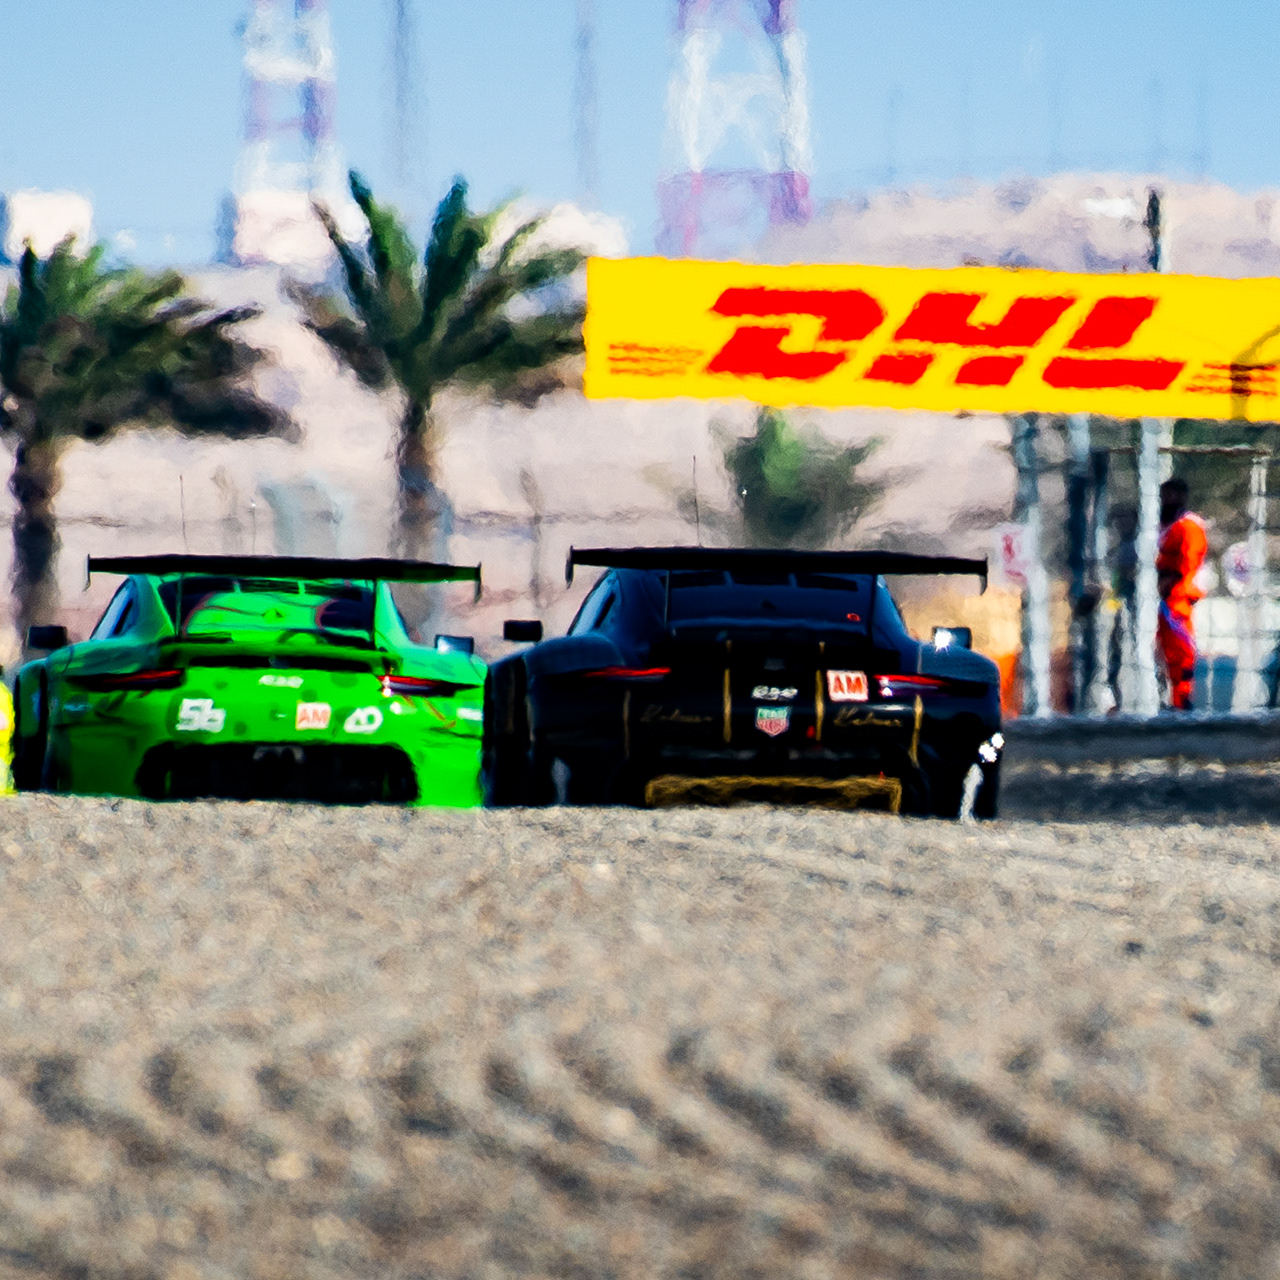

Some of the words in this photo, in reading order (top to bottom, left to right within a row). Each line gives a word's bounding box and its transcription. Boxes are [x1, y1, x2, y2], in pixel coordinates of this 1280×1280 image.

[705, 286, 1184, 390] DHL
[832, 674, 864, 695] AM
[176, 698, 227, 733] 56
